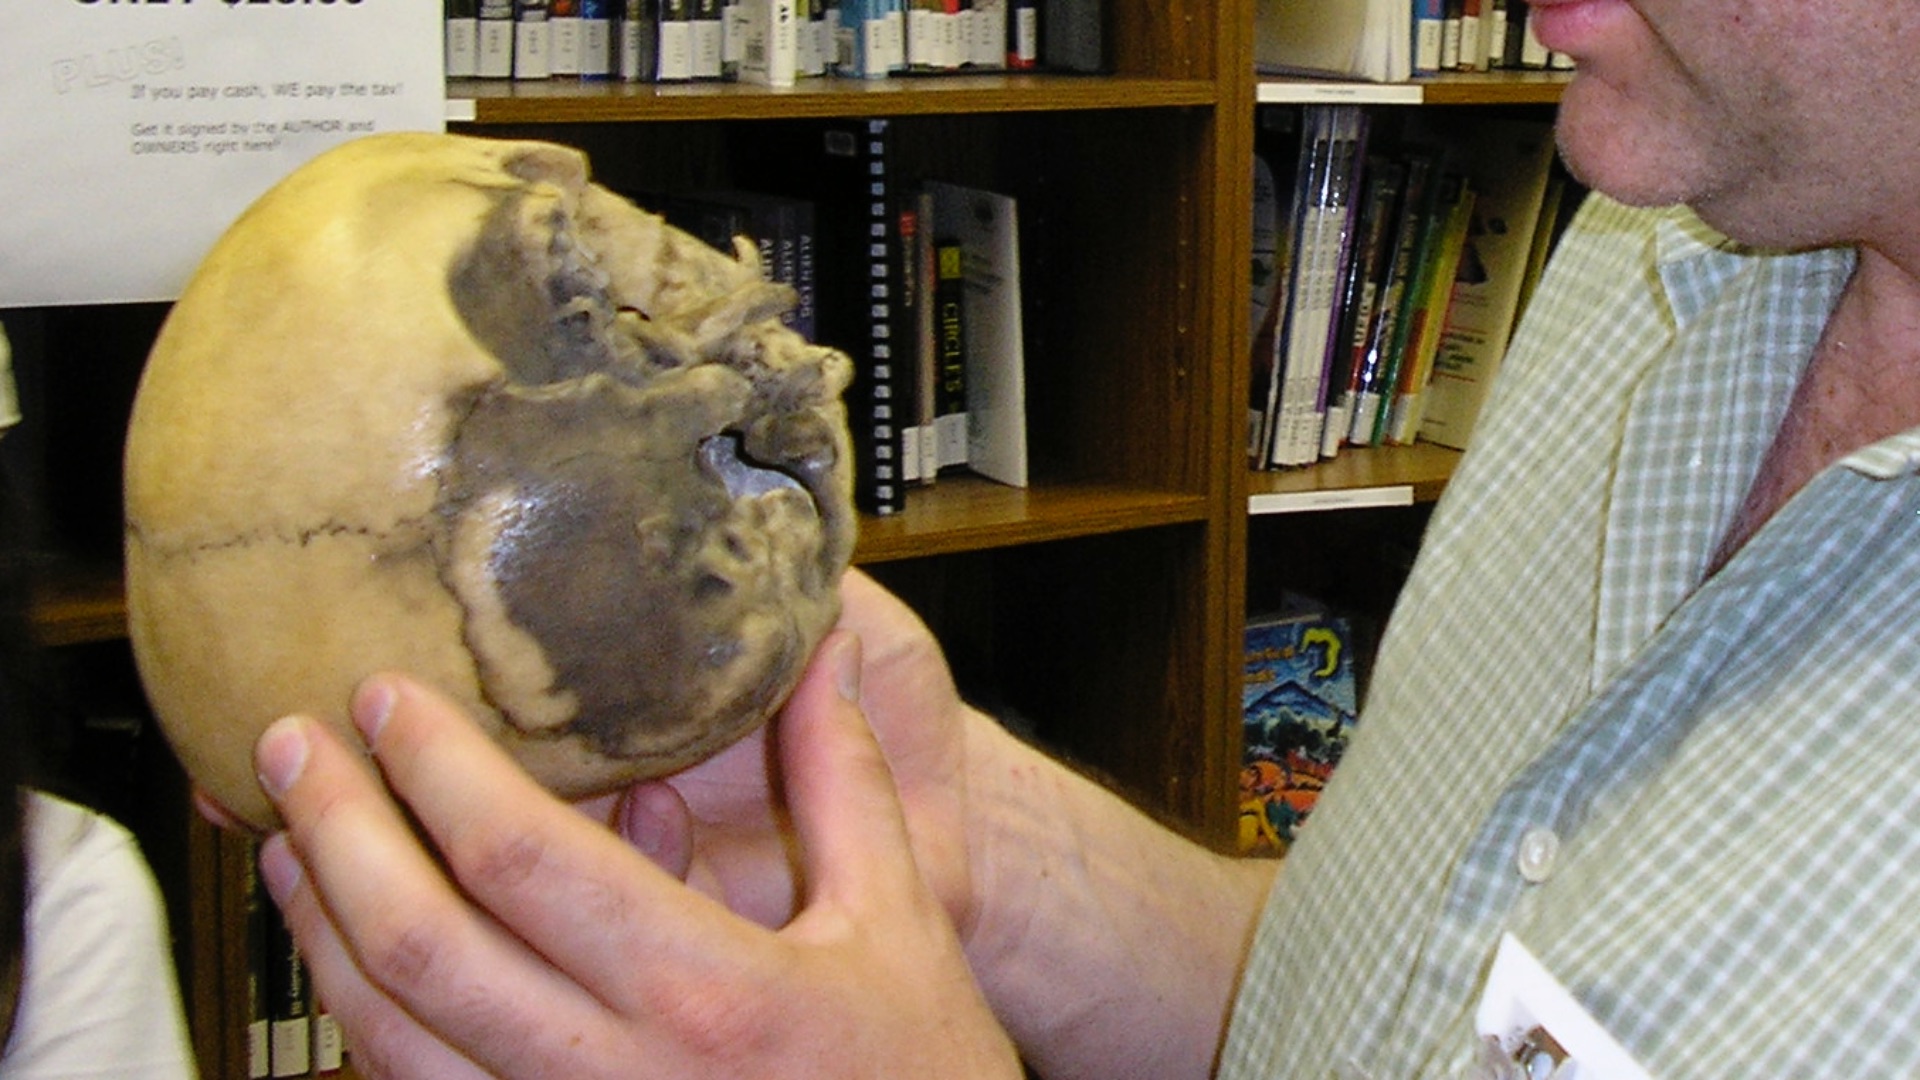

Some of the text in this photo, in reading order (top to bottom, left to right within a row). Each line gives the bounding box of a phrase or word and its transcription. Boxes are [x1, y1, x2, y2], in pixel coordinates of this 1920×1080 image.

[52, 36, 185, 95] PLUS!
[131, 83, 146, 99] If
[151, 85, 182, 101] you
[187, 85, 219, 101] pay
[222, 82, 267, 99] cash,
[272, 81, 299, 97] WE
[305, 84, 336, 99] pay
[340, 82, 368, 96] the
[131, 122, 157, 137] Get
[178, 122, 227, 138] signed
[252, 121, 277, 134] the
[281, 119, 342, 133] AUTHOR
[346, 119, 375, 132] and
[131, 140, 199, 155] OWNERS
[204, 140, 239, 156] right
[800, 234, 813, 318] ALIEN LOG
[942, 302, 962, 392] CIRCLES
